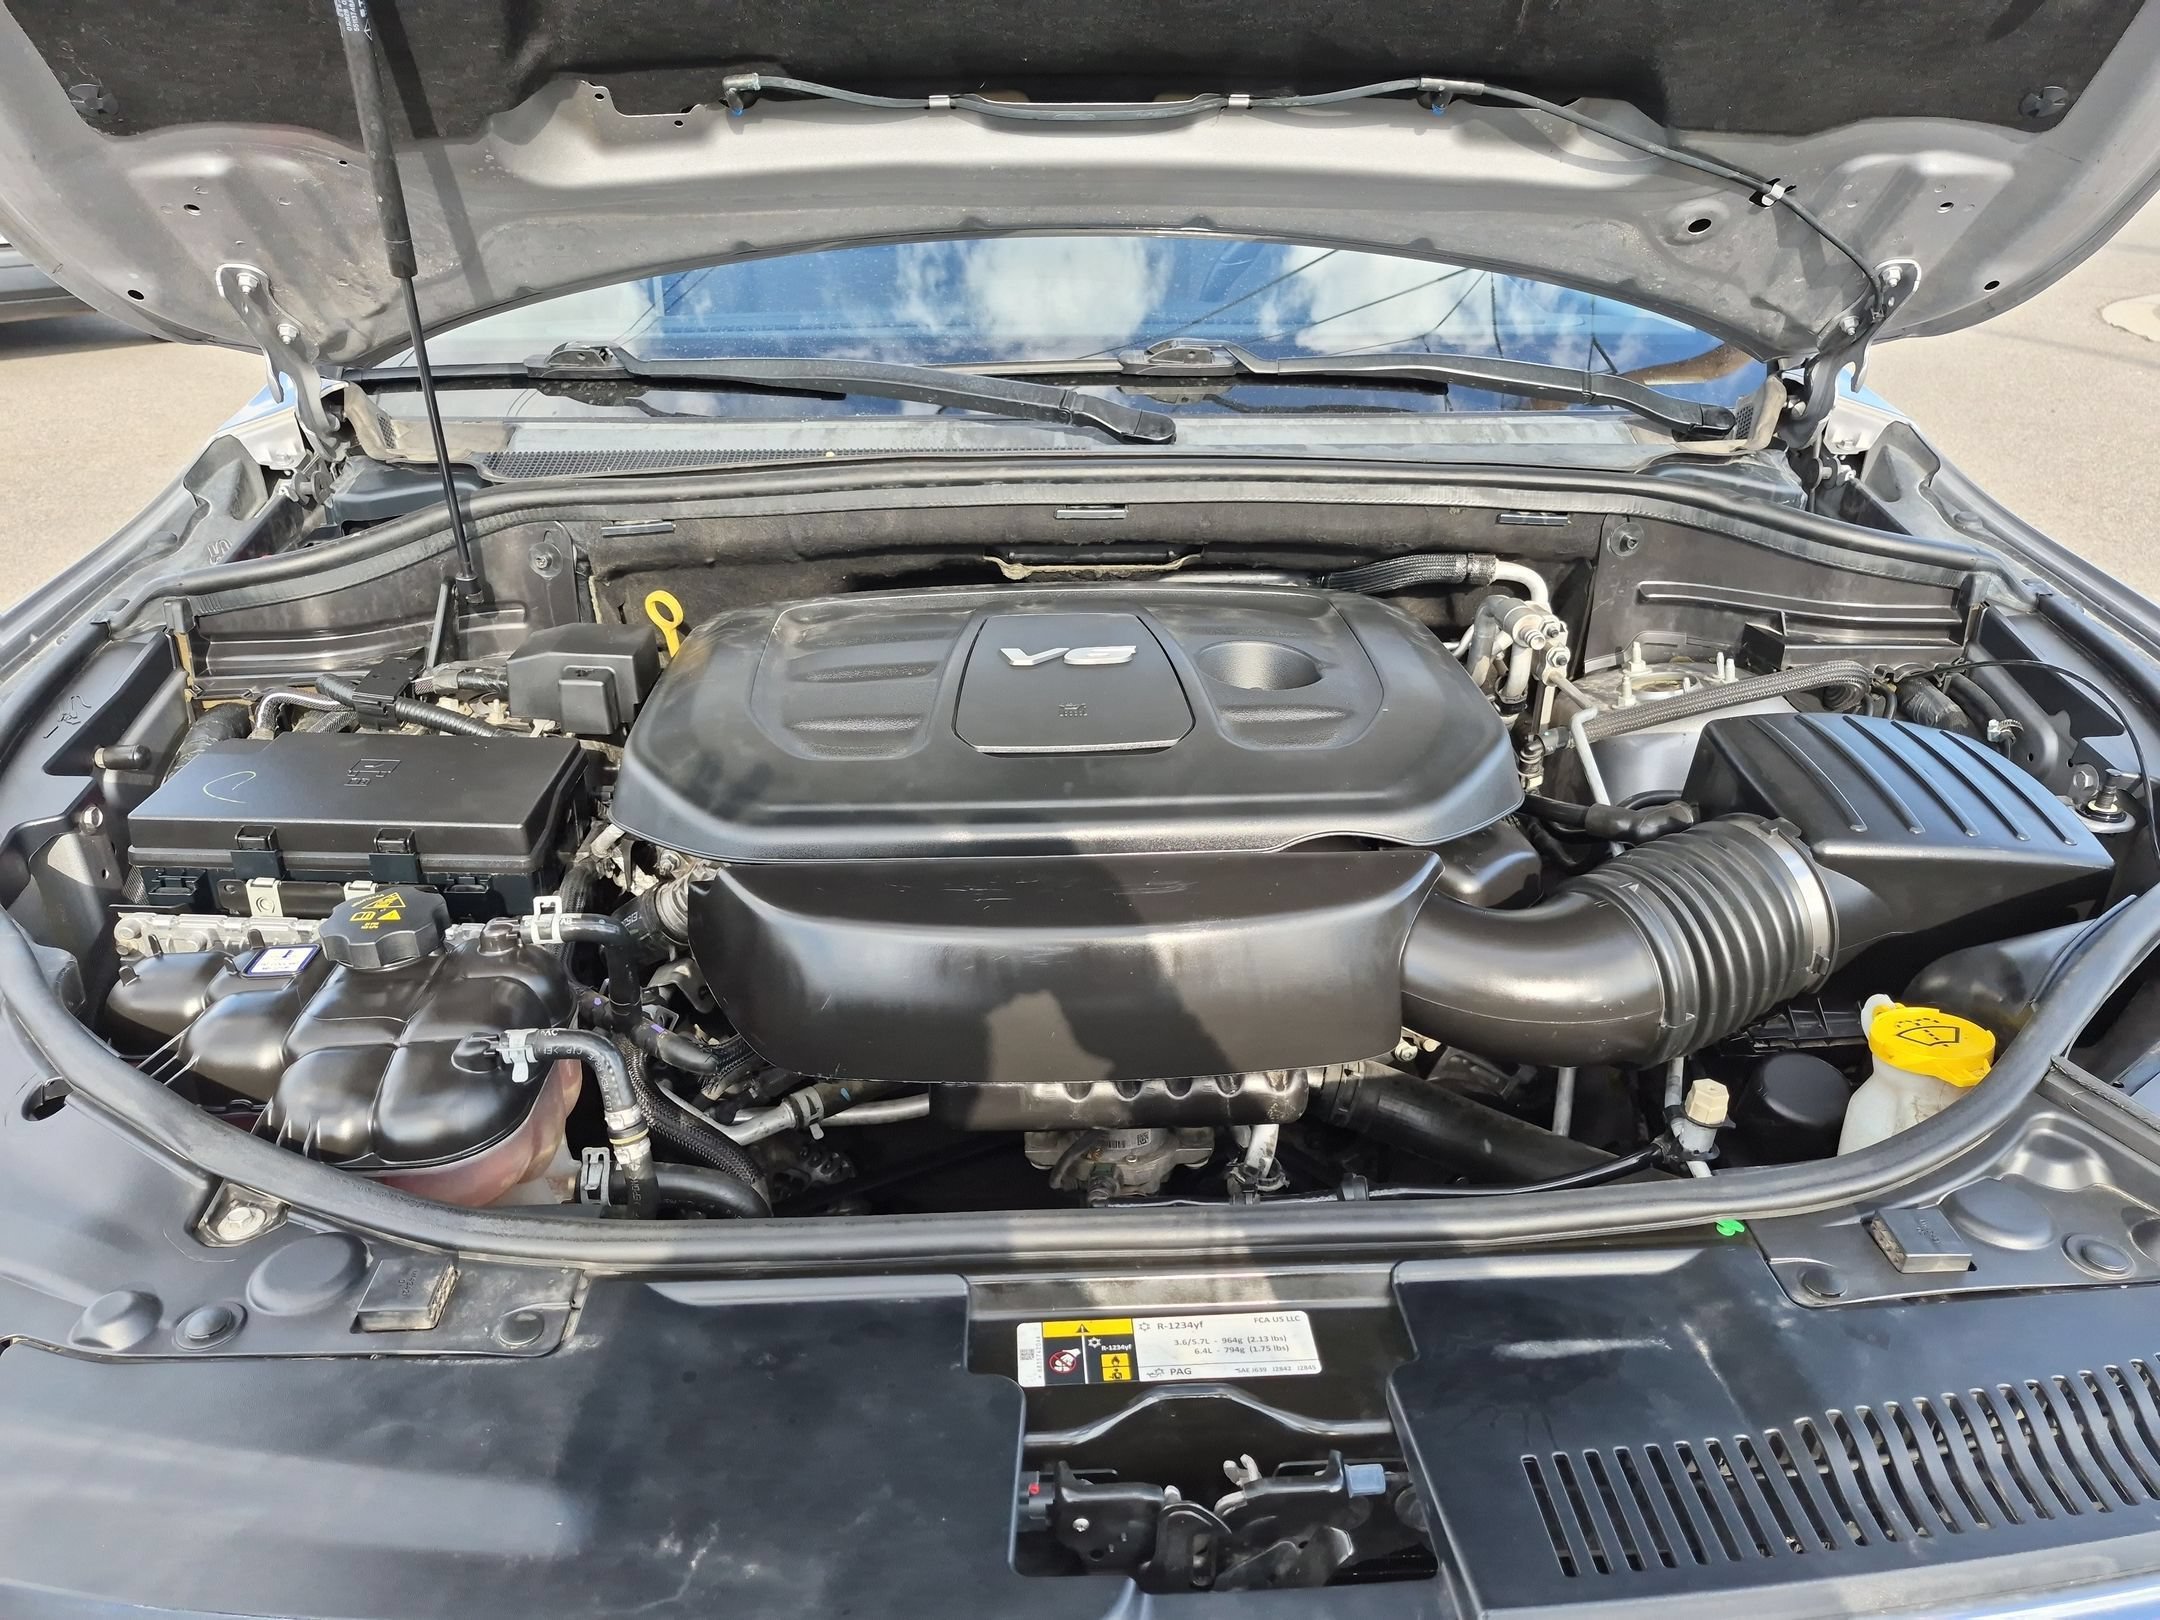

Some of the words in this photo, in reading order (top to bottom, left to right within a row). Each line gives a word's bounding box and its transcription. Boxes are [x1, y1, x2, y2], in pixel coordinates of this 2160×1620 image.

[1000, 646, 1137, 666] V6
[1254, 1316, 1271, 1324] FCA
[1157, 1321, 1203, 1330] R-1234yf
[1174, 1338, 1210, 1346] 3.6/5.7L
[1221, 1337, 1243, 1345] 964g
[1247, 1335, 1269, 1344] (2.13
[1101, 1344, 1132, 1352] R-1234yf
[1194, 1347, 1212, 1355] 6.4L
[1224, 1346, 1245, 1354] 794g
[1249, 1345, 1271, 1353] (1.75
[1170, 1367, 1192, 1376] PAG
